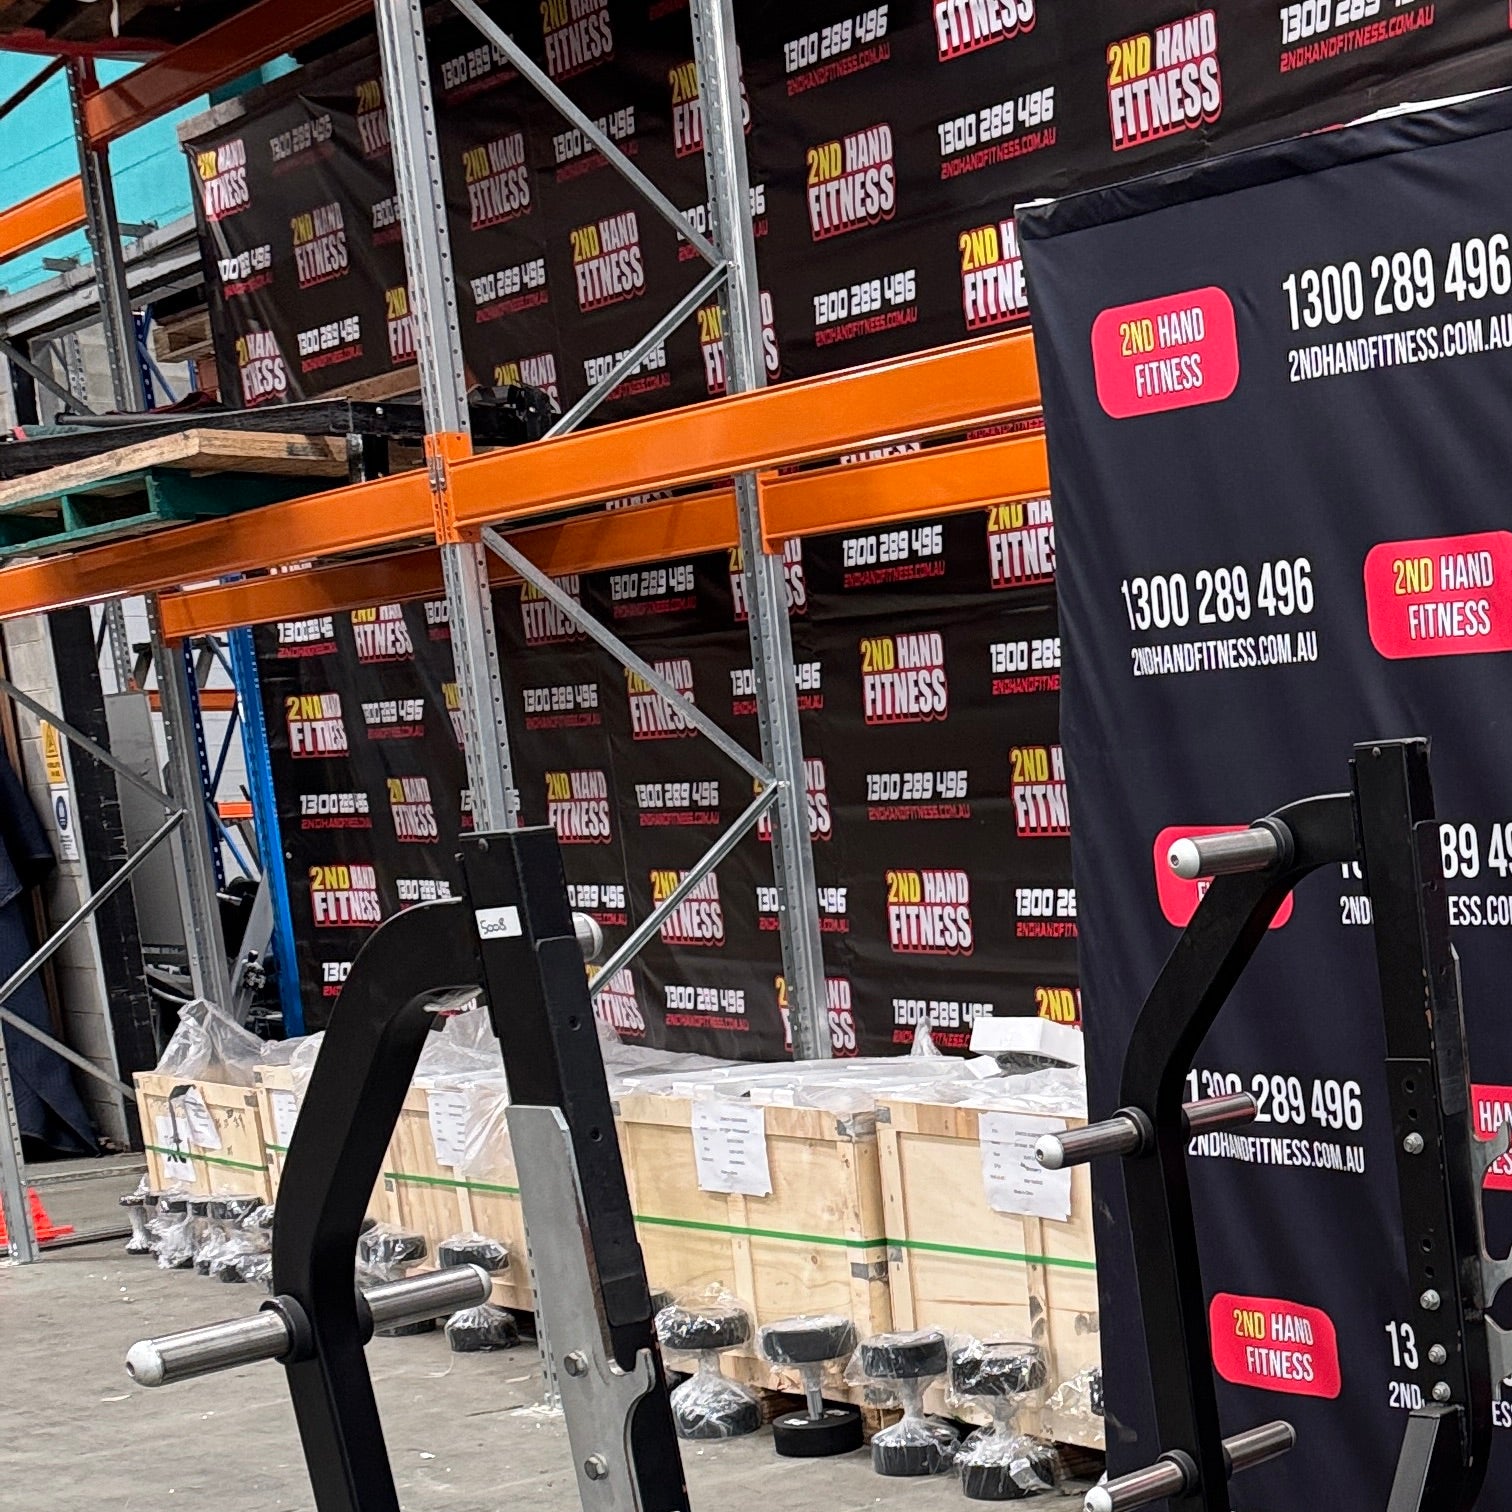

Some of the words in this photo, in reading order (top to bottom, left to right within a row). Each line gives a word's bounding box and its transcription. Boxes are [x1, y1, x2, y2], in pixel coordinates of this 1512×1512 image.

[784, 31, 818, 73] 1300
[821, 18, 852, 59] 289
[855, 4, 889, 44] 496
[1280, 0, 1330, 46] 1300
[1107, 35, 1151, 86] 2ND
[1154, 11, 1217, 67] HAND
[938, 113, 976, 156] 1300
[979, 100, 1014, 143] 289
[1017, 86, 1055, 128] 496
[1111, 54, 1220, 141] FITNESS
[462, 146, 489, 182] 2ND
[807, 141, 842, 183] 2ND
[845, 125, 893, 172] HAND
[467, 166, 530, 224] FITNESS
[808, 164, 895, 232] FITNESS
[571, 226, 599, 262] 2ND
[600, 212, 640, 251] HAND
[959, 226, 998, 271] 2ND
[576, 245, 644, 306] FITNESS
[813, 288, 848, 325] 1300
[851, 279, 881, 316] 289
[884, 269, 917, 306] 496
[963, 262, 1028, 321] FITNE
[1282, 260, 1364, 331] 1300
[1370, 247, 1432, 319] 289
[1443, 233, 1512, 302] 496
[1119, 318, 1155, 357] 2ND
[1157, 306, 1206, 348] HAND
[1134, 352, 1204, 398] FITNESS
[843, 536, 877, 568] 1300
[879, 530, 909, 562] 289
[911, 525, 943, 557] 496
[1120, 571, 1189, 632] 1300
[1197, 565, 1252, 625] 289
[1257, 557, 1315, 616] 496
[1392, 558, 1434, 596] 2ND
[1438, 550, 1494, 590] HAND
[1408, 600, 1491, 641] FITNESS
[861, 639, 895, 673] 2ND
[896, 633, 944, 669] HAND
[1131, 630, 1318, 677] 2NDHANDFITNESS.COM.AU
[863, 669, 946, 717] FITNESS
[866, 773, 900, 801] 1300
[902, 771, 933, 800] 289
[936, 770, 967, 798] 496
[1010, 747, 1048, 782] 2ND
[886, 872, 921, 903] 2ND
[922, 871, 969, 904] HAND
[1015, 888, 1053, 917] 1300
[889, 905, 972, 948] FITNESS
[1036, 989, 1075, 1022] 2ND
[1251, 1073, 1306, 1125] 289
[1311, 1079, 1363, 1131] 496
[1232, 1309, 1265, 1341] 2ND
[1270, 1315, 1315, 1346] HAND
[1246, 1346, 1315, 1383] FITNESS
